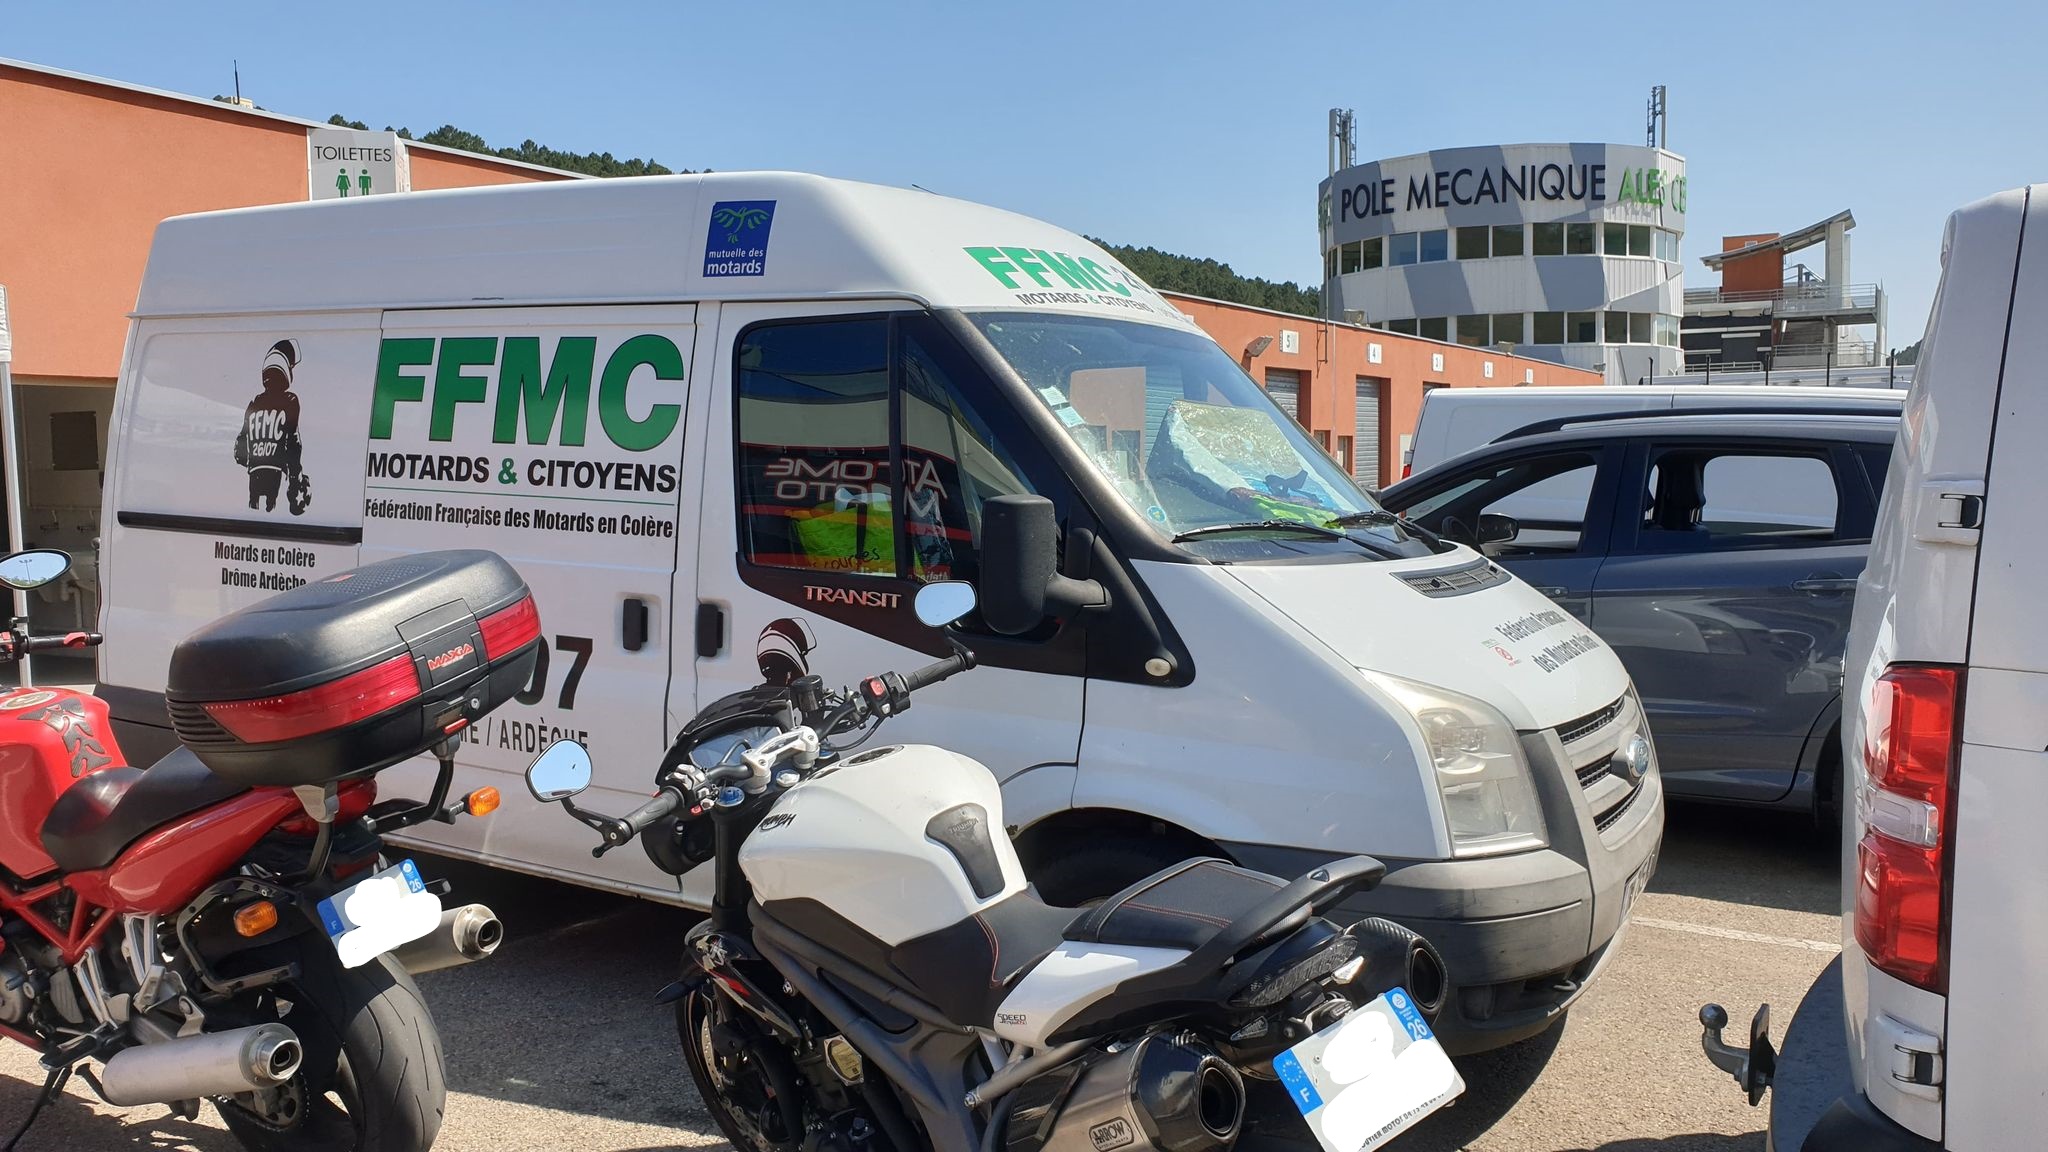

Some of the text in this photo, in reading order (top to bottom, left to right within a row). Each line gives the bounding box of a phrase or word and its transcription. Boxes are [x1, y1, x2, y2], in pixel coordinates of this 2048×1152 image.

[314, 145, 392, 162] TOILETTES
[1341, 178, 1395, 223] POLE
[1406, 163, 1606, 211] MECANIQUE
[708, 247, 764, 258] mutuelle des
[706, 259, 762, 275] motards
[962, 246, 1132, 298] FFMC
[1015, 292, 1089, 306] MOTARDS
[1086, 293, 1101, 304] &
[369, 333, 684, 452] FFMC
[249, 408, 286, 441] FFMC
[252, 442, 278, 457] 26/07
[367, 452, 677, 493] MOTARDS & CITOYENS
[364, 498, 673, 538] Fédération Française des Motards en Colère
[214, 541, 316, 568] Motards en Colère
[221, 567, 257, 588] Drôme
[803, 585, 902, 609] TRANSIT
[409, 878, 422, 893] 26
[331, 920, 338, 931] F
[997, 1013, 1027, 1023] SPEED
[1407, 1018, 1428, 1041] 26
[1299, 1087, 1312, 1104] F
[1093, 1121, 1125, 1145] ARROW
